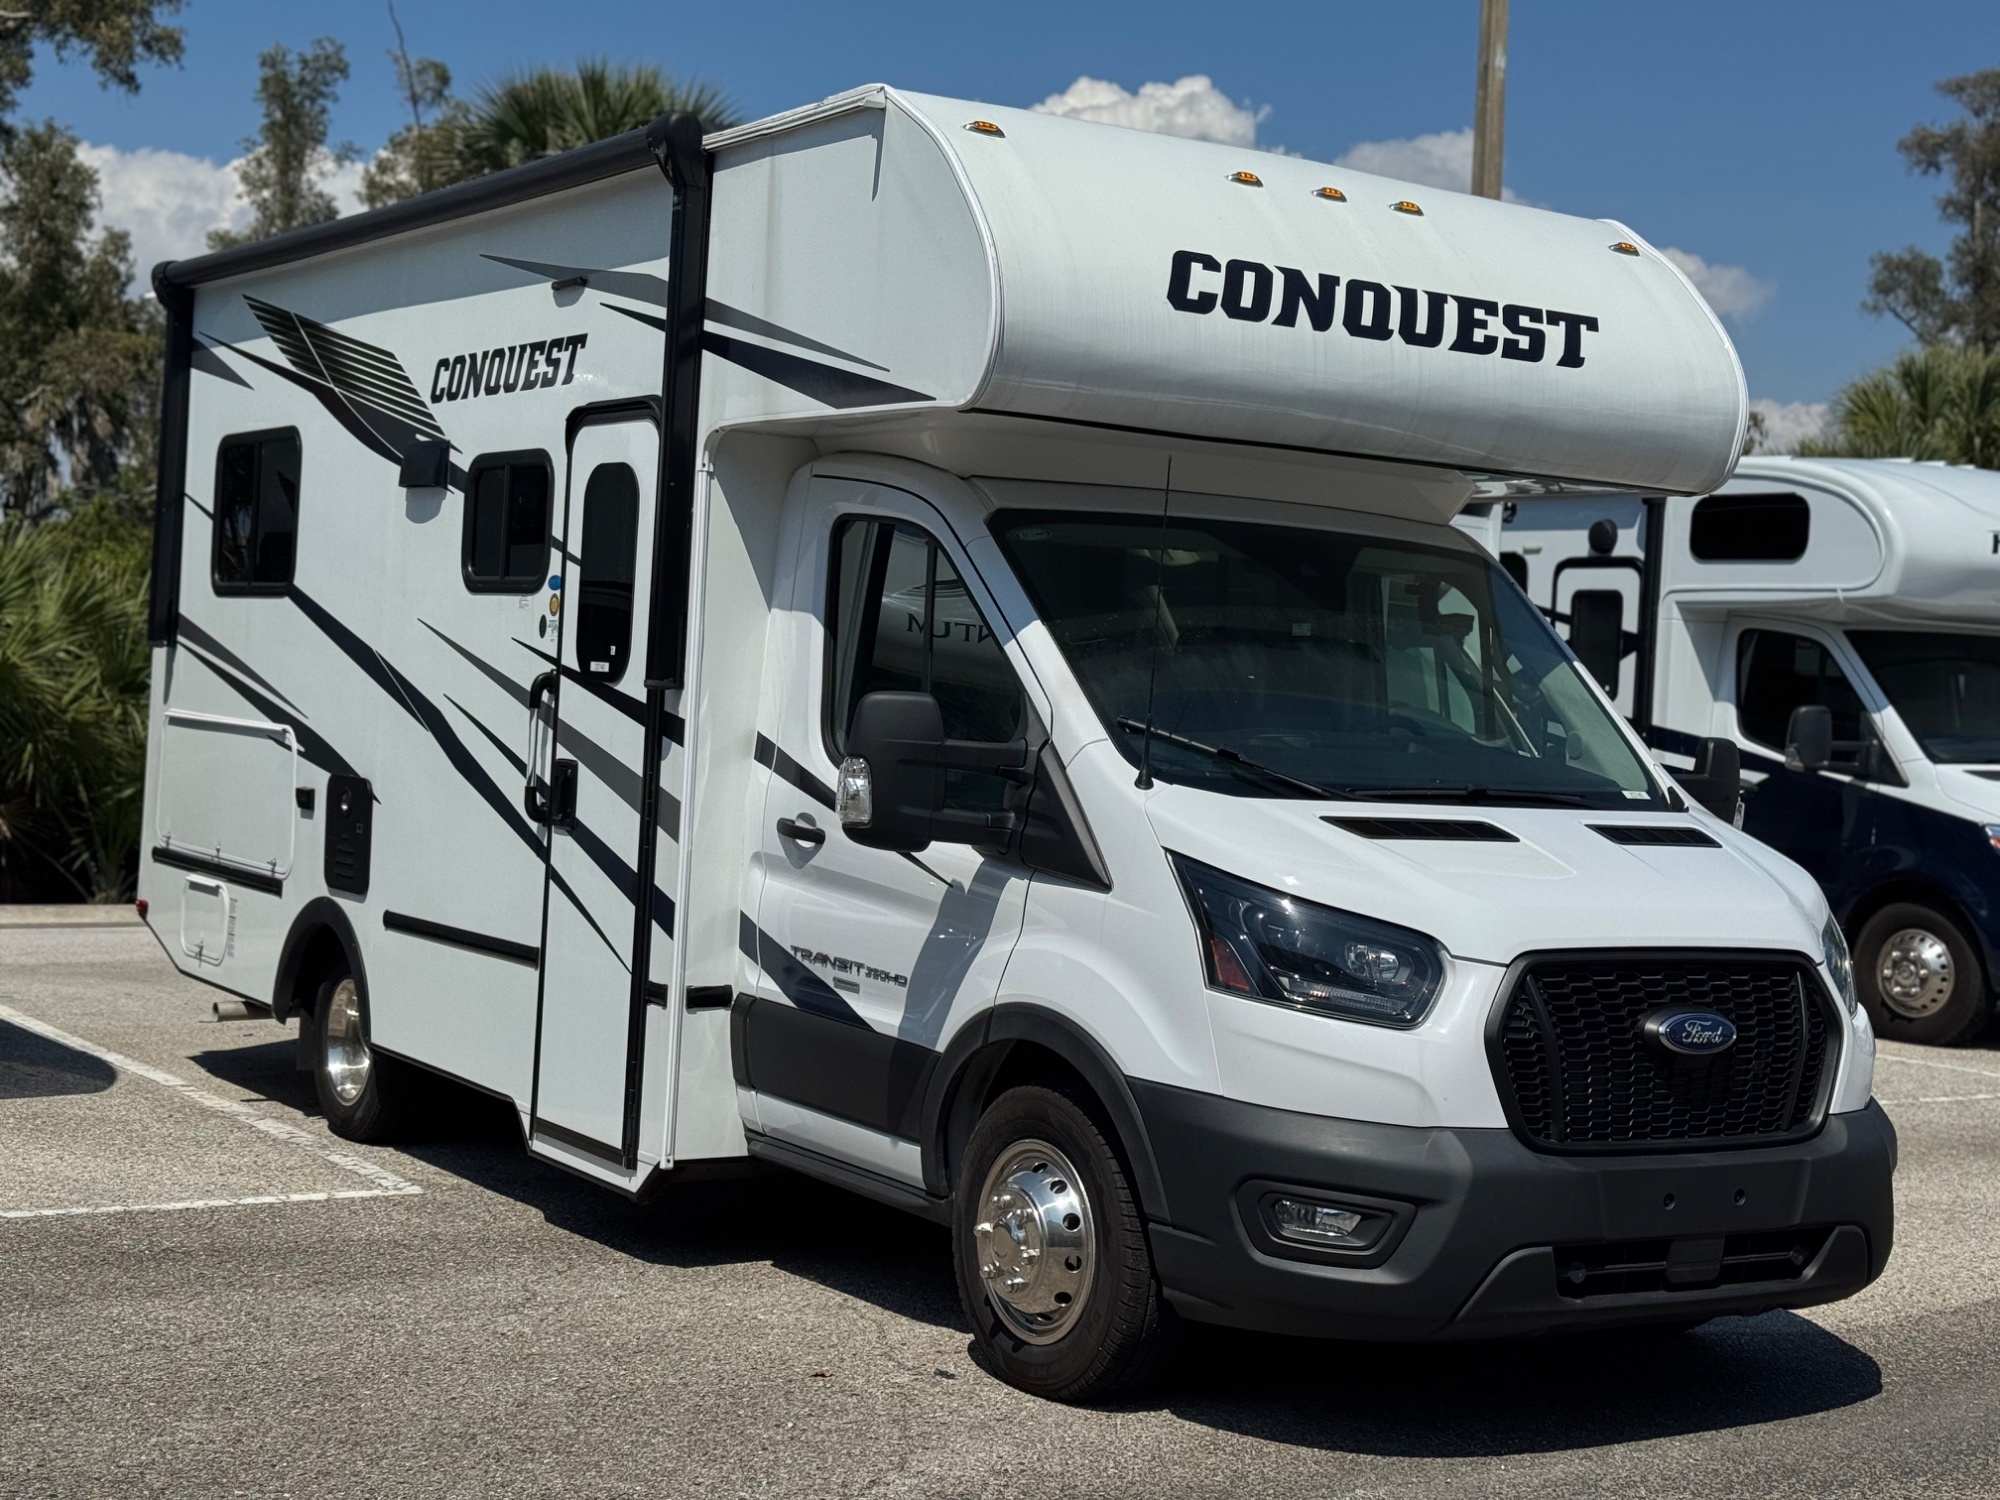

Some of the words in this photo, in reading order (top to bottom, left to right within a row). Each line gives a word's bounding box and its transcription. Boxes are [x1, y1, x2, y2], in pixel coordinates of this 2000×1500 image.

[1167, 250, 1599, 369] CONQUEST
[430, 333, 588, 404] CONQUEST
[791, 945, 865, 976] TRANSIT
[1682, 1020, 1722, 1043] Ford
